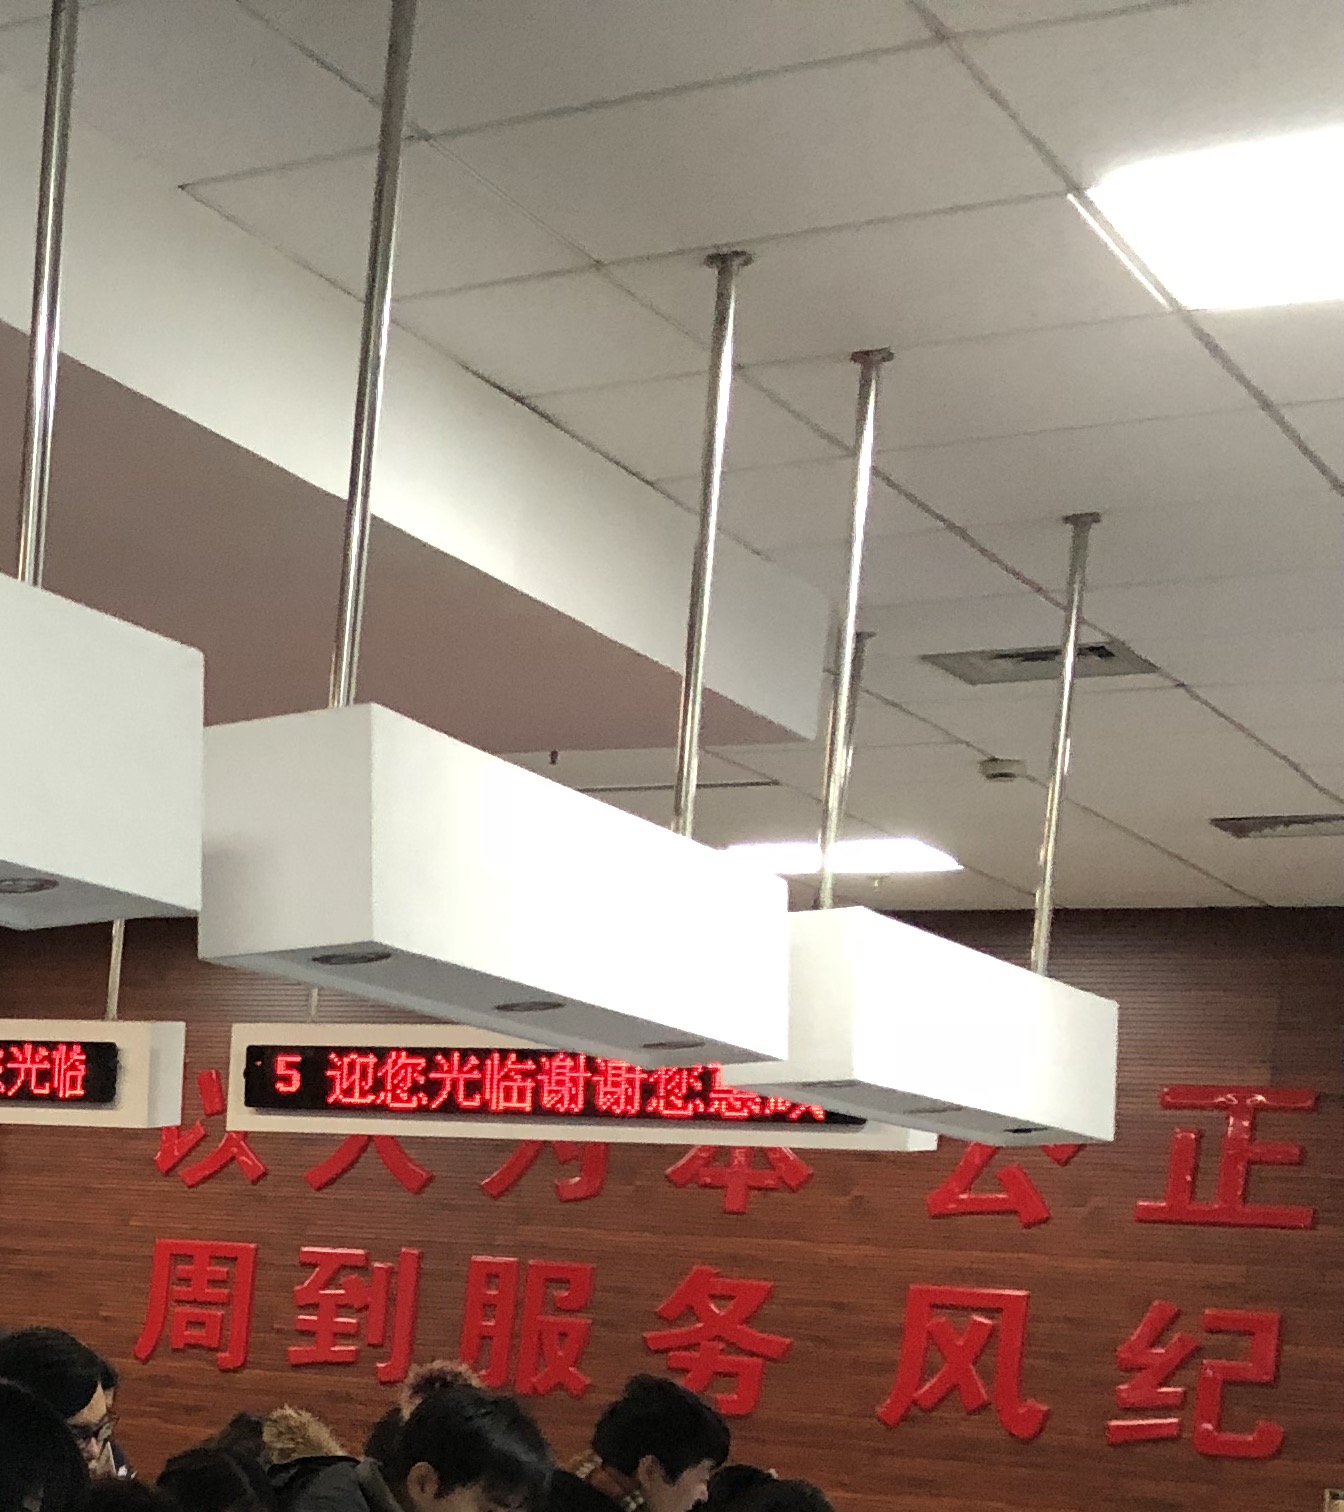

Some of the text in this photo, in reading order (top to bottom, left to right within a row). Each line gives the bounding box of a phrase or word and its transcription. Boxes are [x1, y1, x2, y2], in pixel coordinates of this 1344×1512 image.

[274, 1053, 301, 1094] 5
[134, 1237, 1287, 1459] 周到服务 风纪
